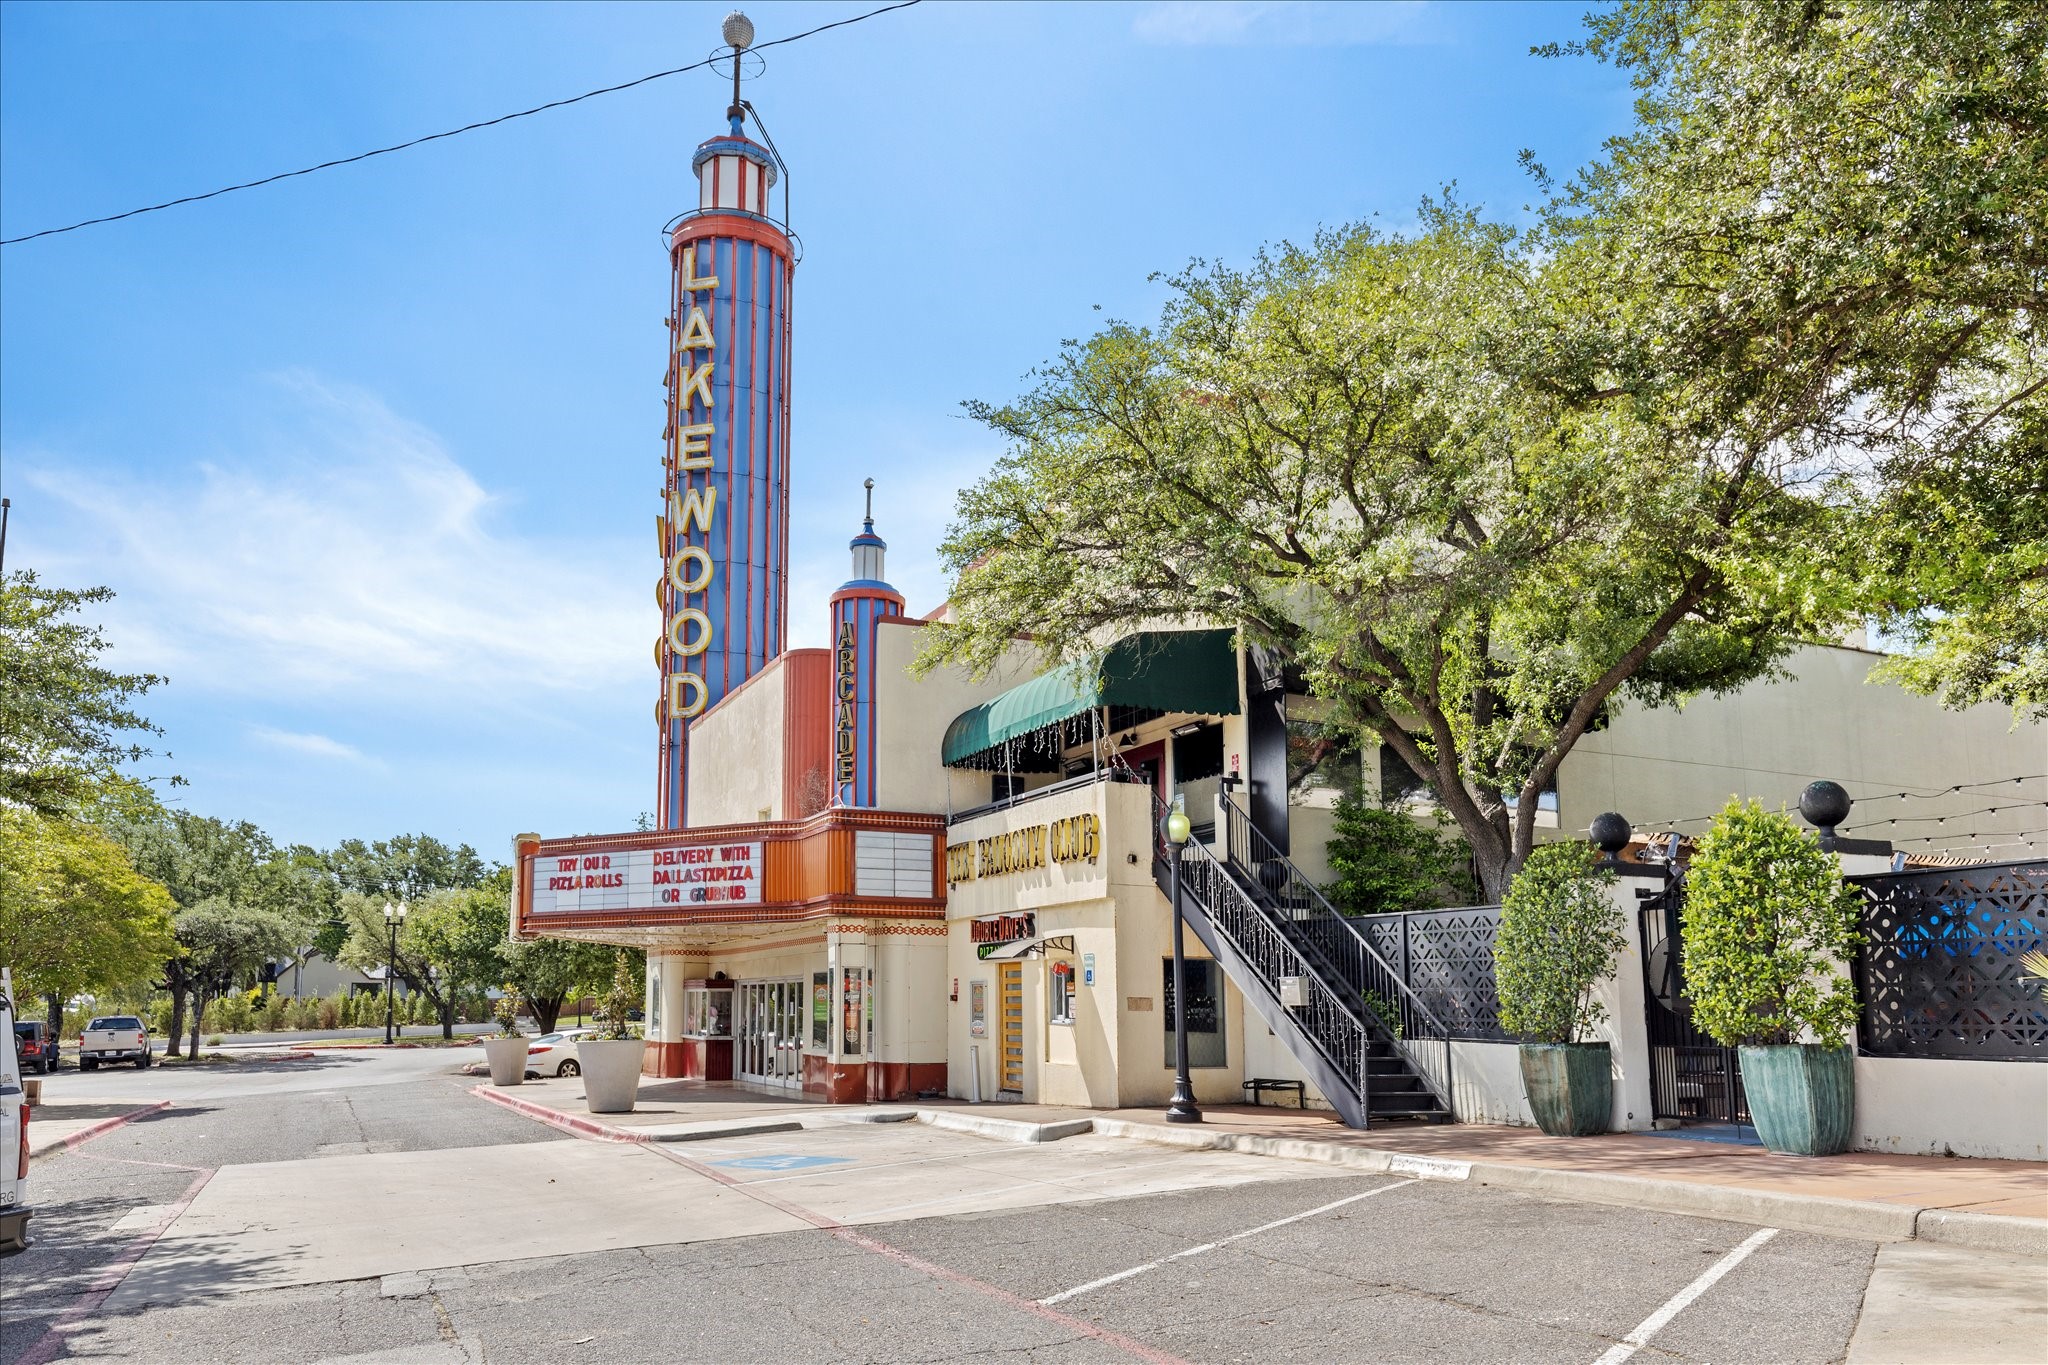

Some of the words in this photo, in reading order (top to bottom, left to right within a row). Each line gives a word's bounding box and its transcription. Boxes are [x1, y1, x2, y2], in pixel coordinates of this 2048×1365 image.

[669, 248, 719, 719] LAKEWOOD
[837, 621, 854, 784] ARCADE
[1050, 813, 1100, 864] CLUB
[557, 858, 578, 872] TRY
[584, 856, 610, 871] OUR
[654, 847, 713, 866] DELIVERY
[720, 846, 750, 861] WITH
[549, 876, 582, 890] PIZZA
[586, 874, 622, 888] ROLLS
[653, 865, 754, 885] DALLASTXPIZZA
[661, 888, 680, 903] OR
[689, 885, 746, 902] GRUBHUB
